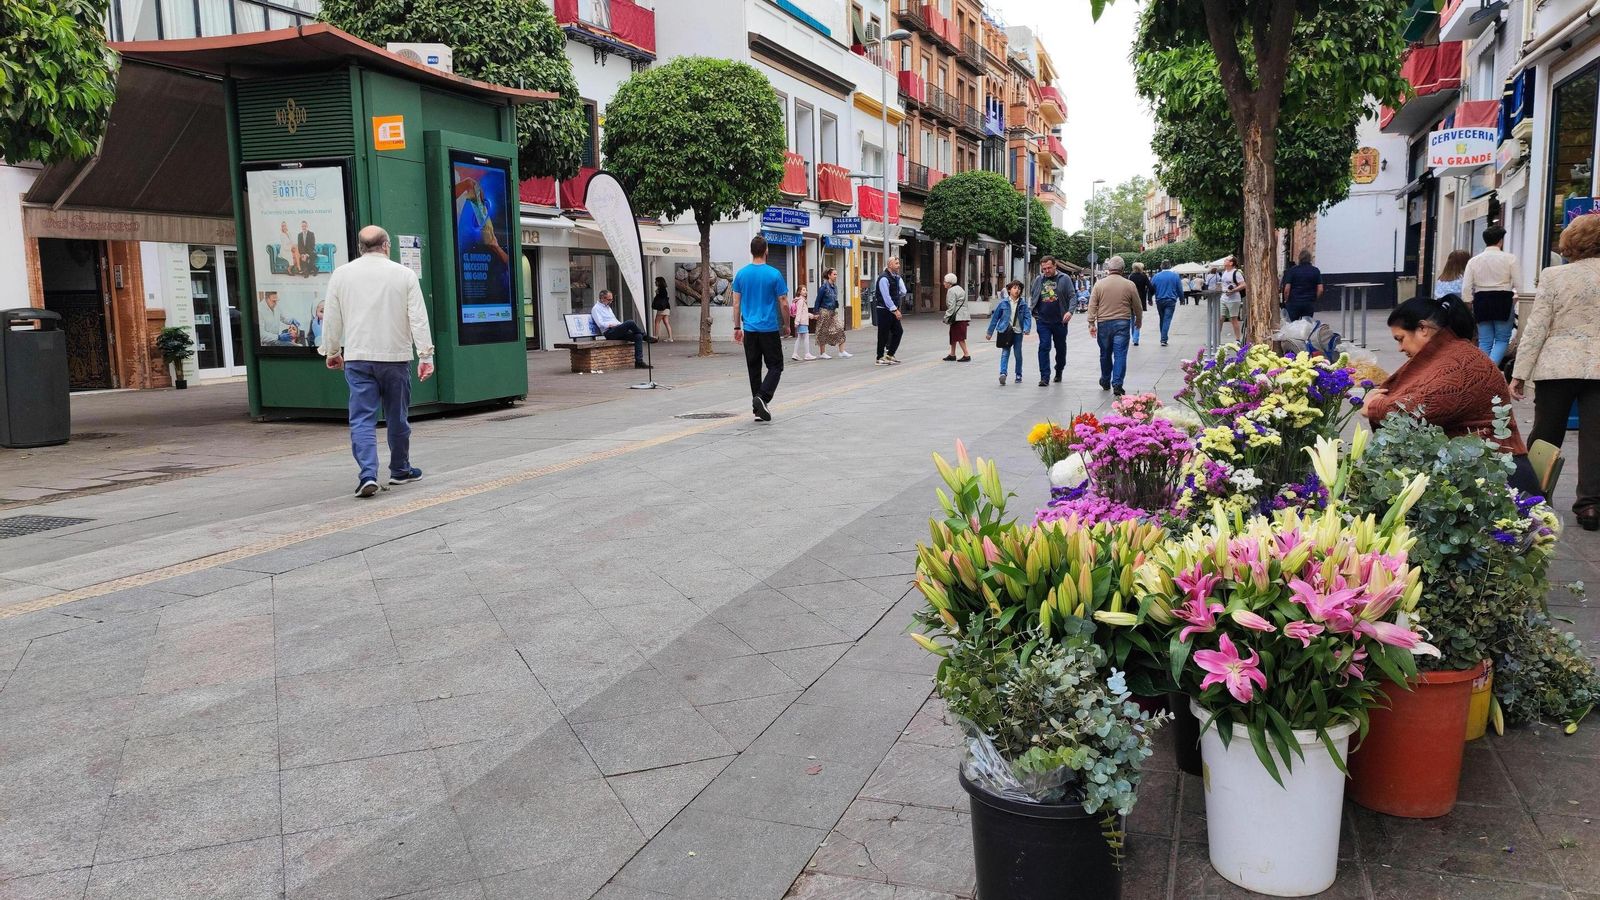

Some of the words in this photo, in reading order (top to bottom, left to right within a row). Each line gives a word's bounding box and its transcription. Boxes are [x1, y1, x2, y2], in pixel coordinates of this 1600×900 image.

[1431, 129, 1494, 146] CERVECERIA
[1432, 156, 1443, 165] LA
[1447, 152, 1492, 165] GRANDE
[279, 186, 304, 198] ORTIZ
[463, 253, 470, 261] EL
[463, 262, 488, 270] NECESITA
